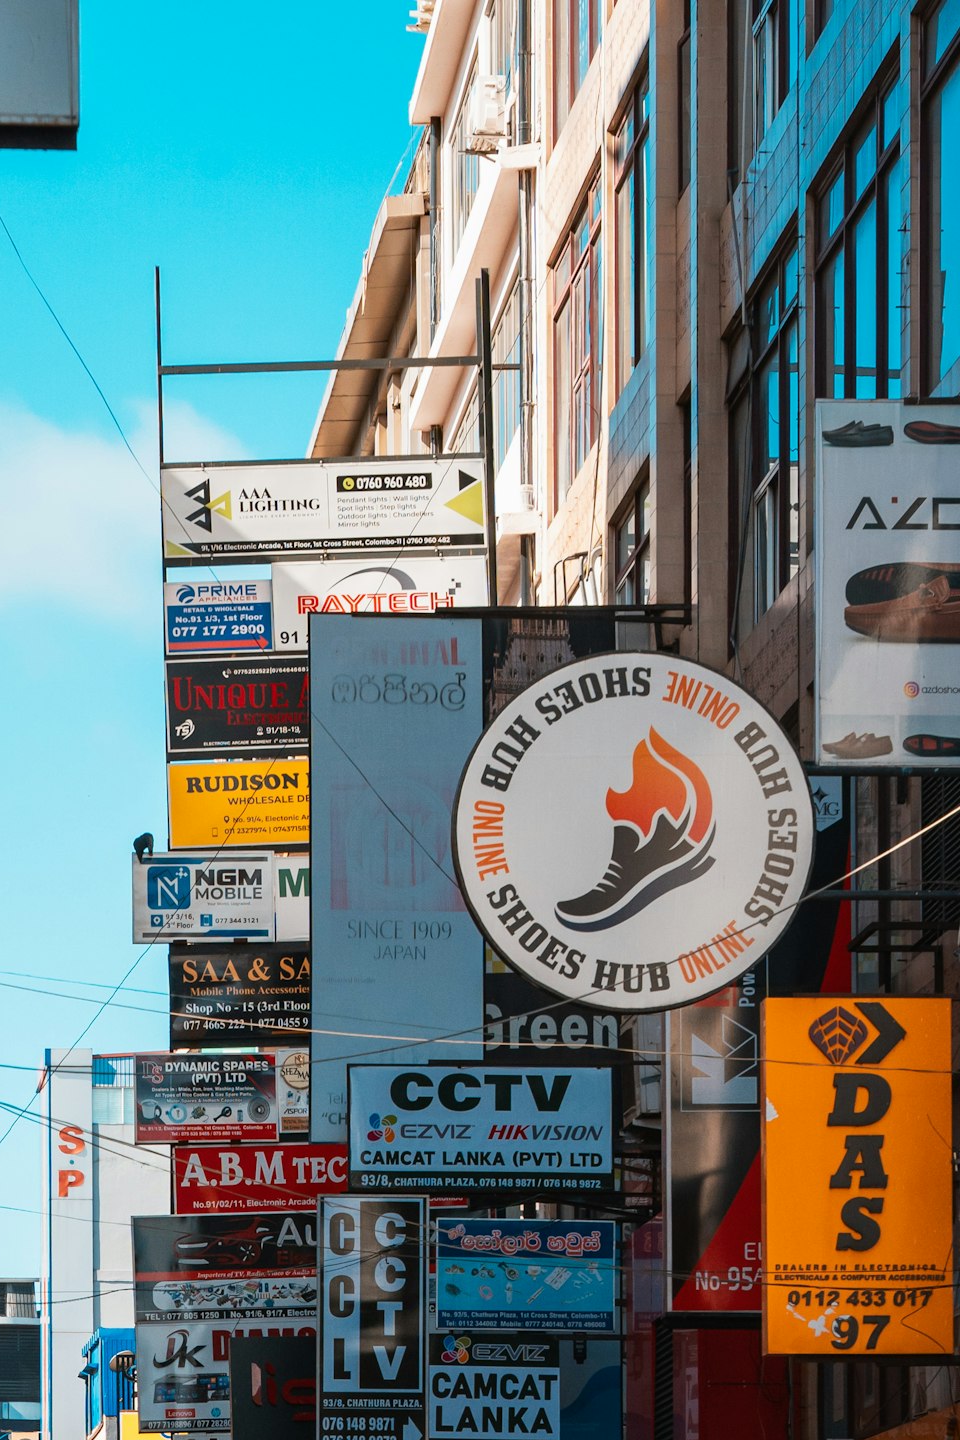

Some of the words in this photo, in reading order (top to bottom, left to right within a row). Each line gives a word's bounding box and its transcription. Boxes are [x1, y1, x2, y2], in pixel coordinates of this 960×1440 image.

[356, 477, 383, 490] 0760
[384, 476, 405, 489] 960
[405, 475, 427, 488] 480
[239, 487, 272, 500] AAA
[240, 498, 321, 513] LIGHTING
[197, 584, 257, 597] PRIME
[198, 595, 258, 603] APPLIANCES
[297, 591, 455, 615] RAYTECH
[172, 626, 198, 637] 077
[202, 625, 227, 636] 177
[230, 624, 265, 636] 2900
[534, 666, 653, 727] SHOES
[662, 670, 741, 731] ONLINE
[480, 714, 542, 793] HUB
[734, 721, 793, 800] HUB
[186, 773, 299, 794] RUDISON
[228, 795, 294, 806] WHOLESALE
[473, 800, 510, 882] ONLINE
[744, 807, 798, 927] SHOES
[195, 869, 262, 886] NGM
[195, 888, 262, 900] MOBILE
[347, 919, 404, 940] SINCE
[411, 920, 452, 940] 1909
[486, 883, 587, 980] SHOES
[591, 958, 672, 994] HUB
[677, 920, 756, 985] ONLINE
[373, 945, 427, 961] JAPAN
[183, 958, 242, 984] SAA
[247, 958, 272, 982] &
[165, 1062, 220, 1073] DYNAMIC
[222, 1061, 269, 1072] SPARES
[191, 1073, 222, 1086] (PVT)
[225, 1072, 247, 1083] LTD
[390, 1072, 573, 1113] CCTV
[400, 1123, 473, 1140] EZVIZ
[488, 1123, 604, 1142] HIKVISION
[180, 1150, 287, 1188] A.B.M
[360, 1150, 436, 1166] CAMCAT
[442, 1151, 506, 1167] LANKA
[512, 1151, 564, 1169] (PVT)
[569, 1152, 603, 1168] LTD
[827, 1072, 892, 1253] DAS
[775, 1263, 828, 1272] DEALERS
[833, 1263, 847, 1271] IN
[853, 1263, 937, 1272] ELECTRONICS
[786, 1290, 840, 1308] 0112
[845, 1290, 887, 1308] 433
[892, 1290, 934, 1308] 017
[830, 1314, 892, 1351] 97
[471, 1344, 549, 1362] EZVIZ
[431, 1372, 558, 1401] CAMCAT
[322, 1399, 346, 1409] 93/8,
[346, 1399, 391, 1408] CHATHURA
[391, 1399, 423, 1408] PLAZA.
[322, 1416, 344, 1432] 076
[346, 1416, 366, 1431] 148
[369, 1416, 395, 1431] 9871
[435, 1405, 554, 1434] LANKA
